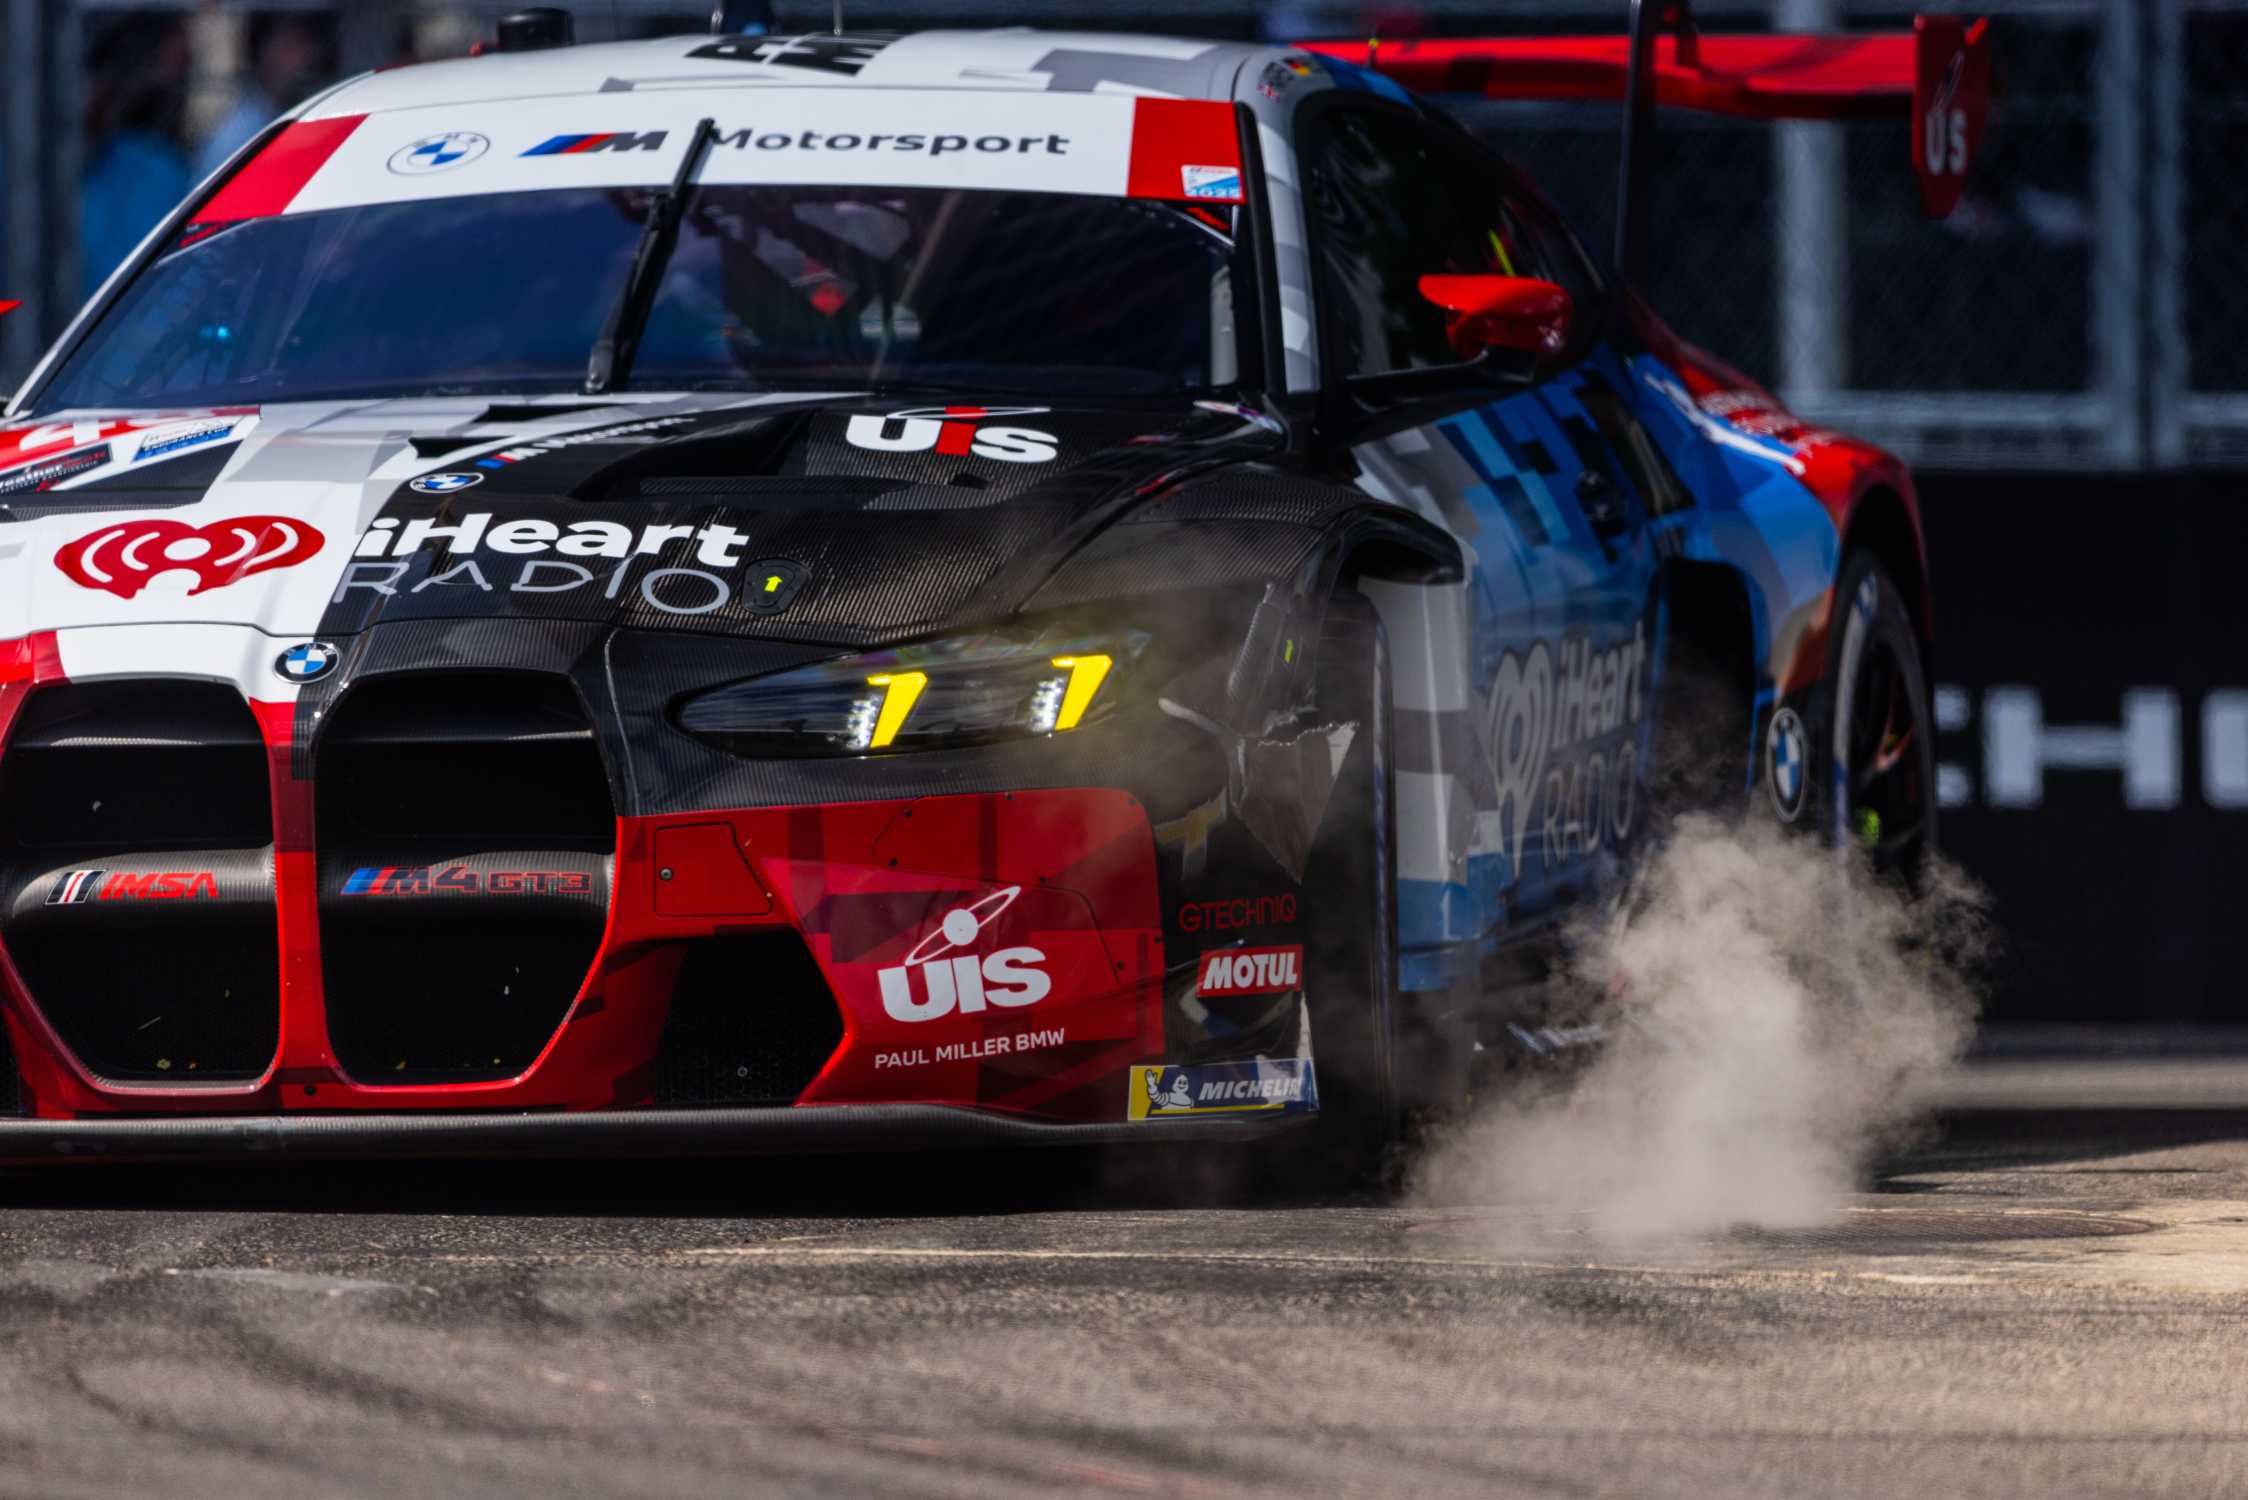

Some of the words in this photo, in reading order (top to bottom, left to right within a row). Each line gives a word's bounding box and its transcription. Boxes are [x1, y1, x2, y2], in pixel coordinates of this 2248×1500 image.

[706, 128, 1071, 156] Motorsport
[354, 512, 750, 568] iHeart
[332, 560, 731, 615] RADIO
[98, 871, 218, 901] IMSA
[488, 871, 593, 894] GT3
[1202, 952, 1297, 990] MOTUL
[875, 1049, 930, 1069] PAUL
[935, 1036, 1010, 1063] MILLER
[1015, 1027, 1065, 1051] BMW
[1198, 1078, 1305, 1101] MICHELIN
